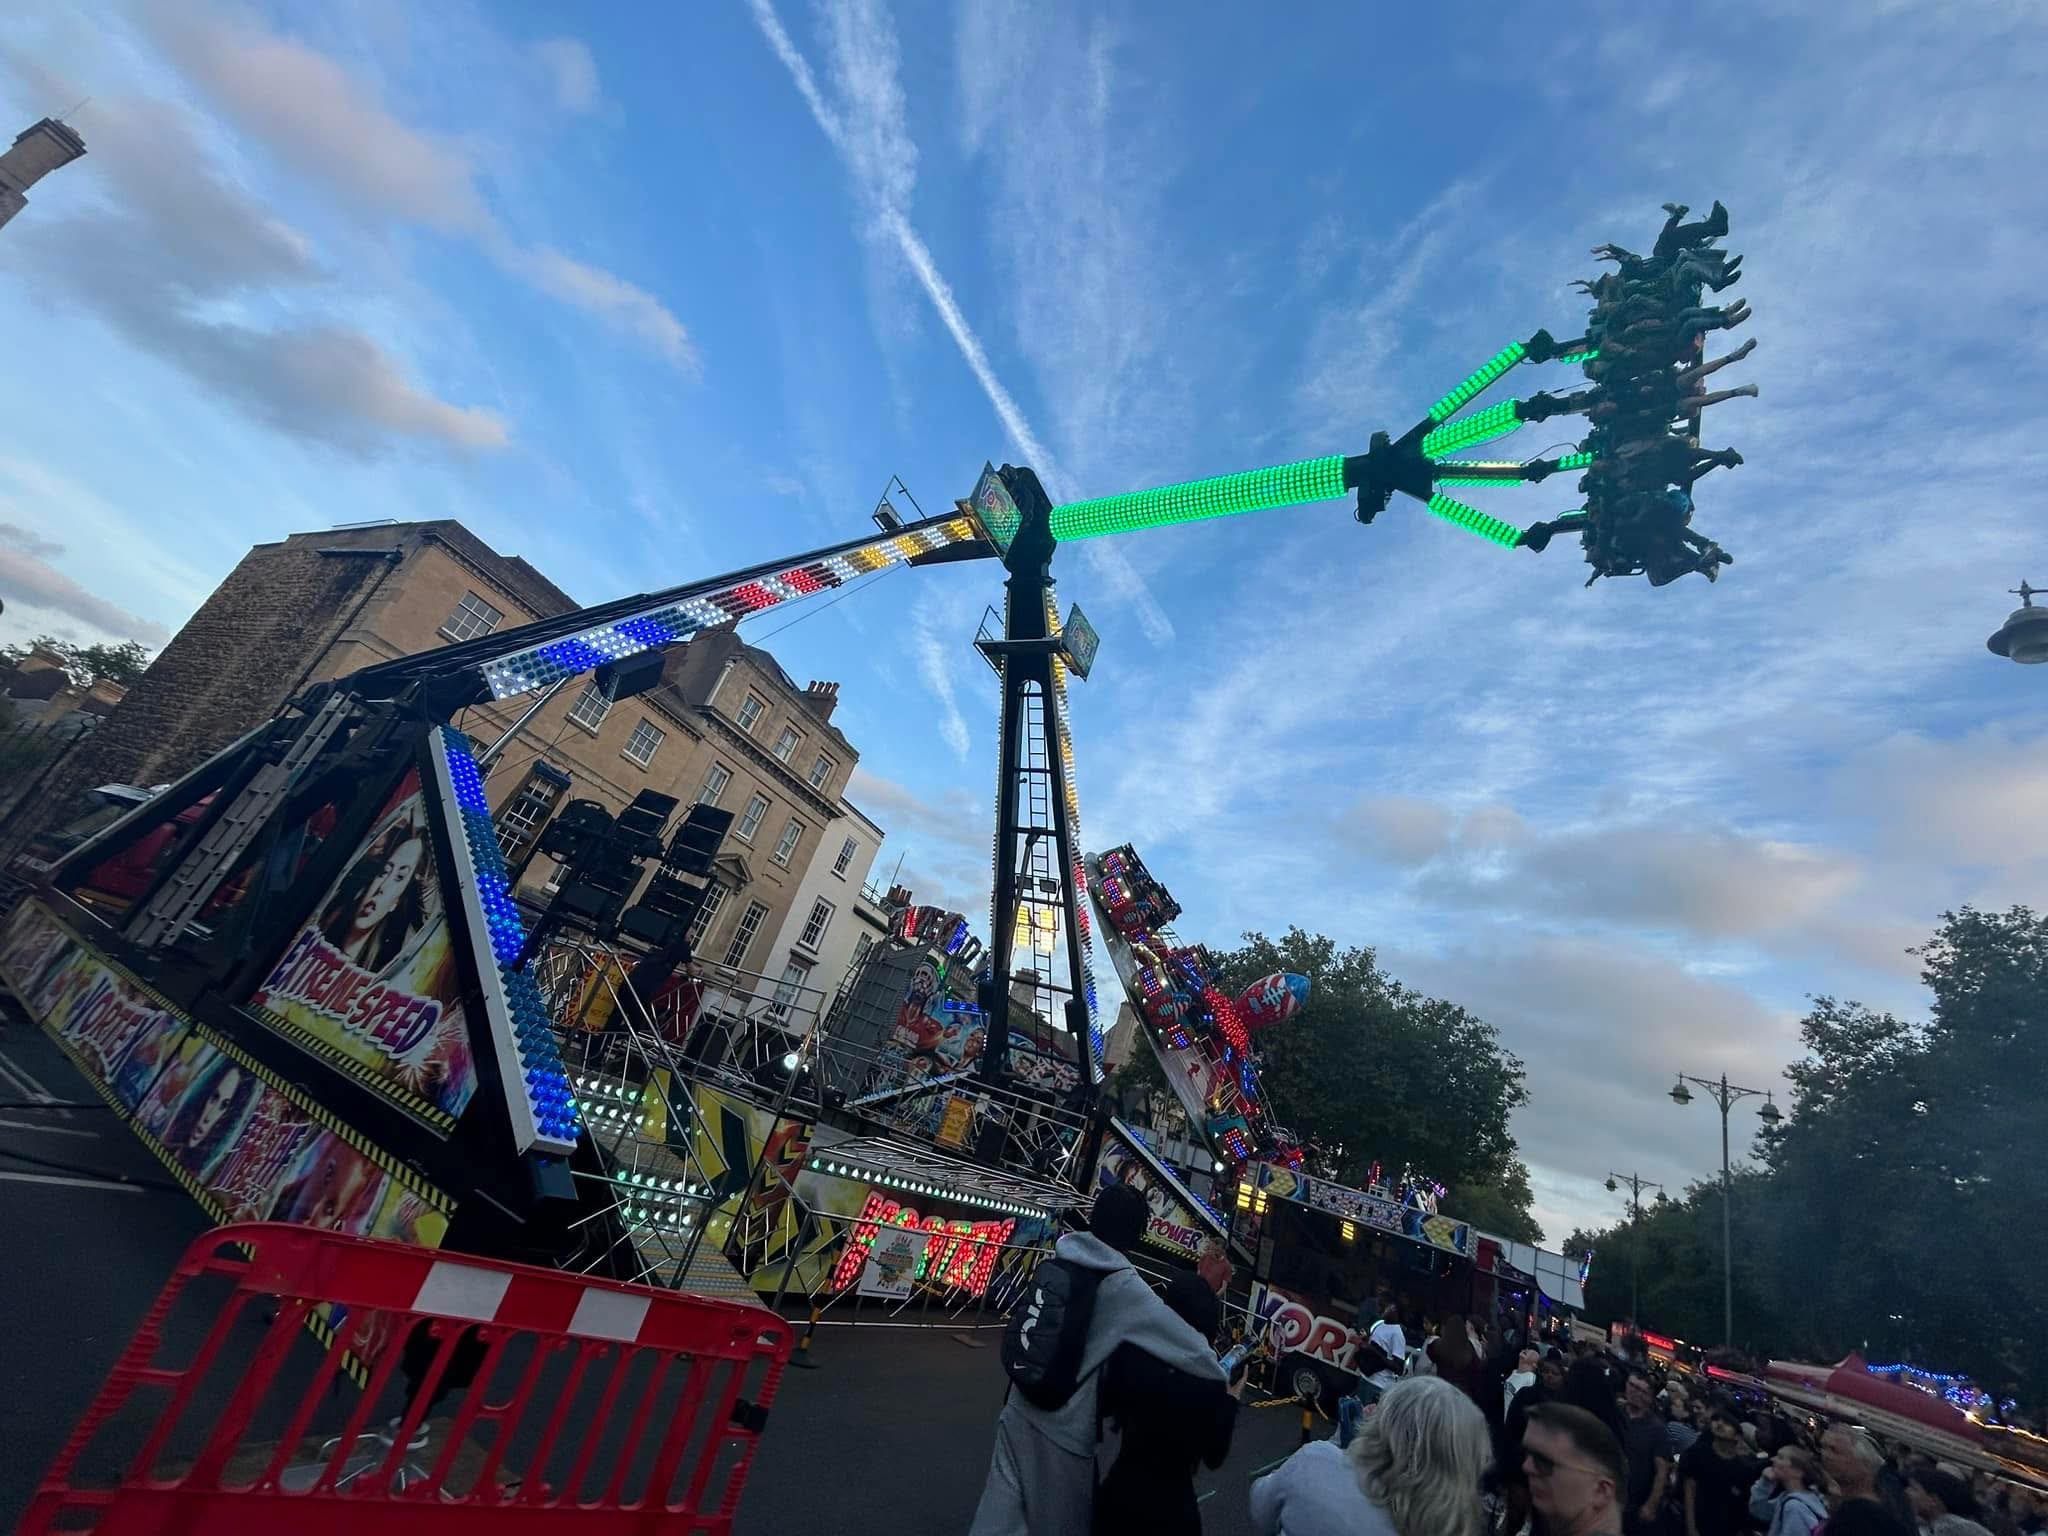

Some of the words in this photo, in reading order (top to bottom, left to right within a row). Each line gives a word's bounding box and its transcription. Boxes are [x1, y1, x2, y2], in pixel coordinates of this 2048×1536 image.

[61, 974, 165, 1083] VORTEX
[260, 927, 376, 1019] EXTREME
[344, 980, 443, 1060] SPEED
[1147, 1216, 1203, 1252] POWER
